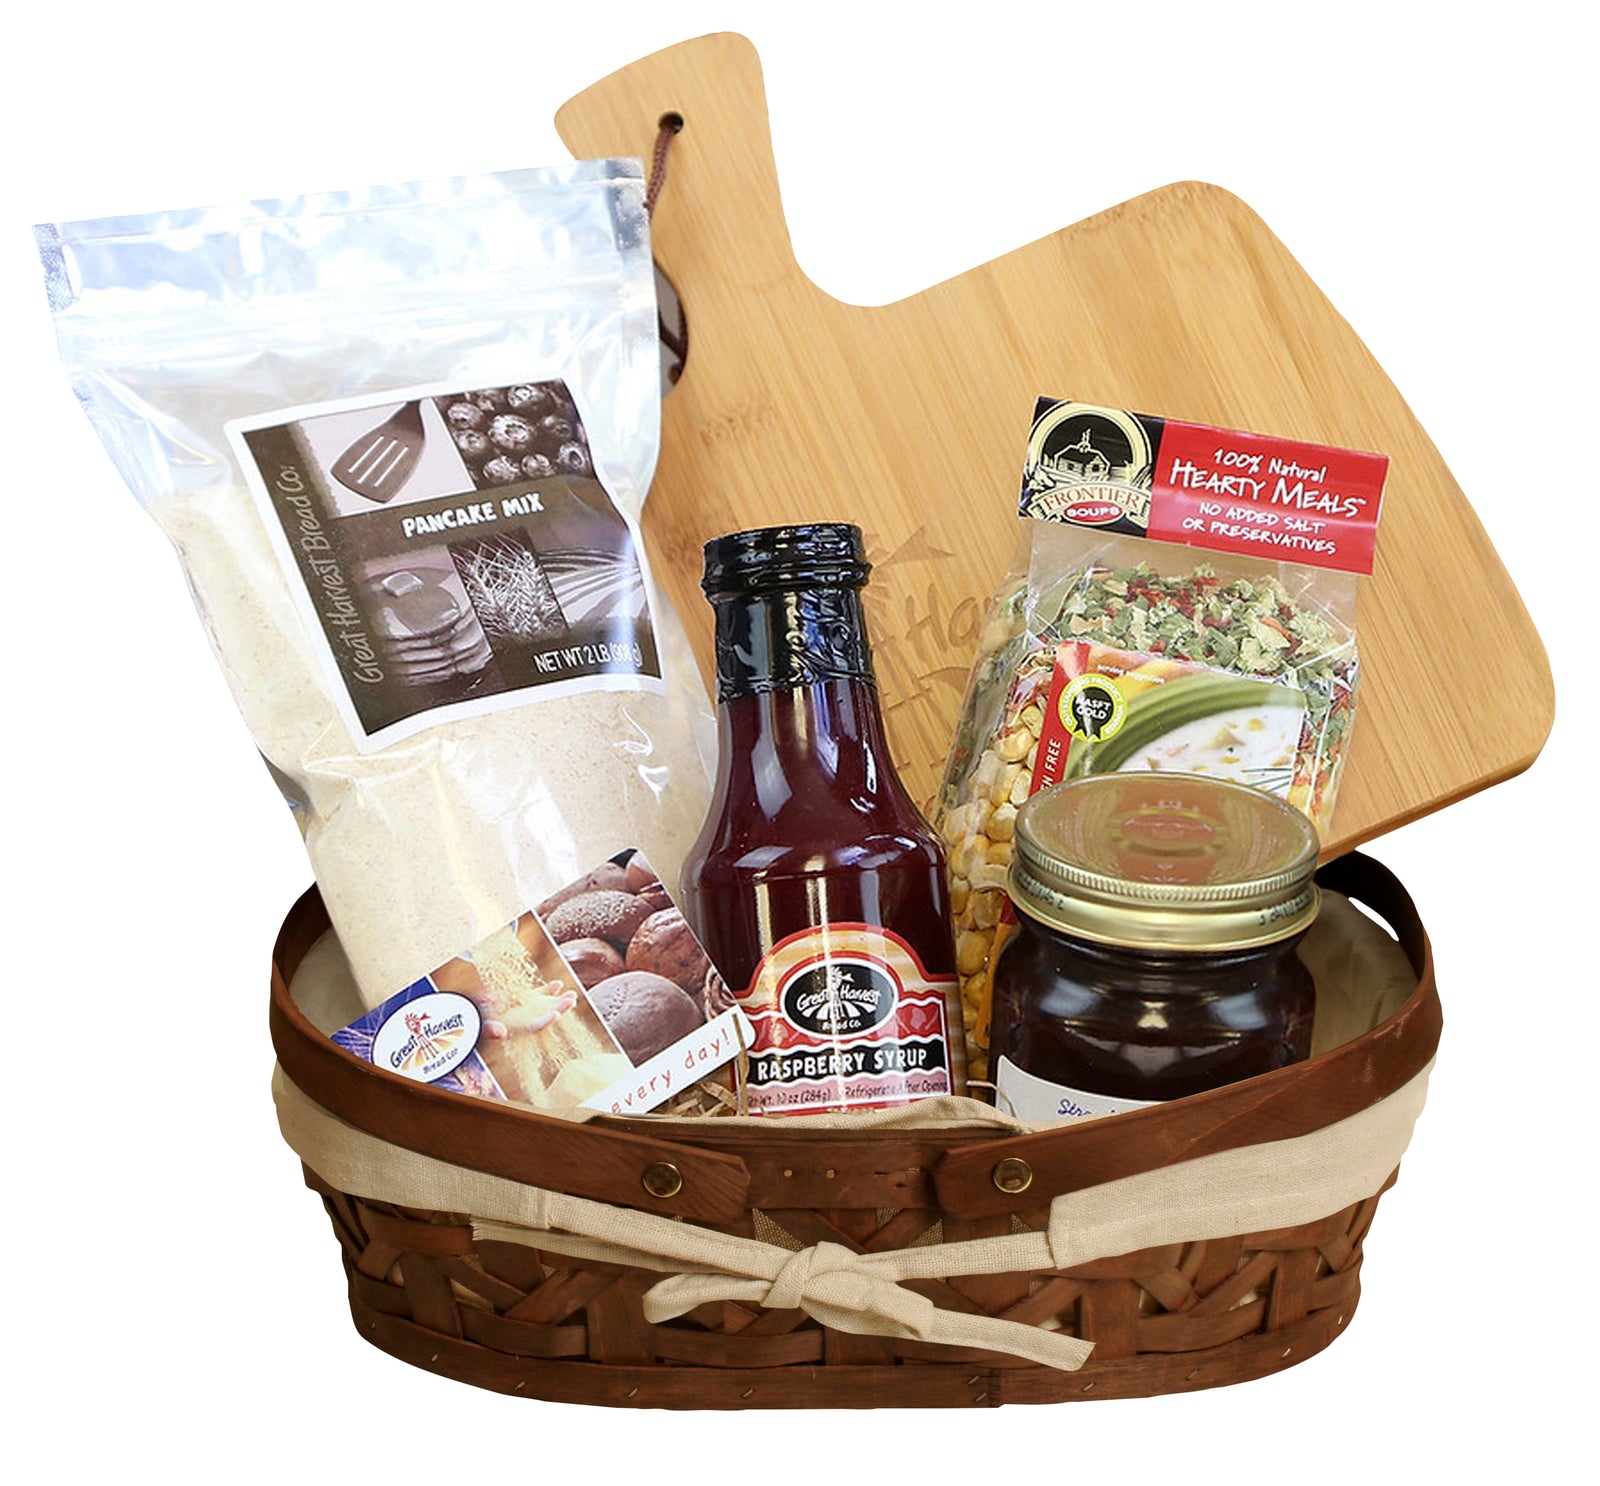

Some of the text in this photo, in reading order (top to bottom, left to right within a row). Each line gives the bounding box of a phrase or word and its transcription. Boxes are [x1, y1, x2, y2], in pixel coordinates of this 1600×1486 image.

[1169, 458, 1265, 501] HEARTY
[1214, 449, 1327, 484] 100% Natural
[1043, 484, 1140, 511] FRONTIER
[1066, 507, 1121, 519] SOUPS
[401, 493, 546, 538] PANCAKE MIX
[1199, 501, 1326, 534] NO ADDED SALT
[1181, 517, 1337, 555] OR PRESERVATIVES
[533, 650, 563, 673] NET
[560, 646, 584, 668] WT
[583, 645, 596, 664] 2
[592, 643, 612, 663] LB
[1044, 738, 1061, 773] FREE
[840, 983, 882, 1006] Harvest
[390, 1013, 465, 1069] Great Harvest
[610, 1028, 731, 1114] every day!
[757, 1048, 928, 1082] RASPBERRY SYRUP
